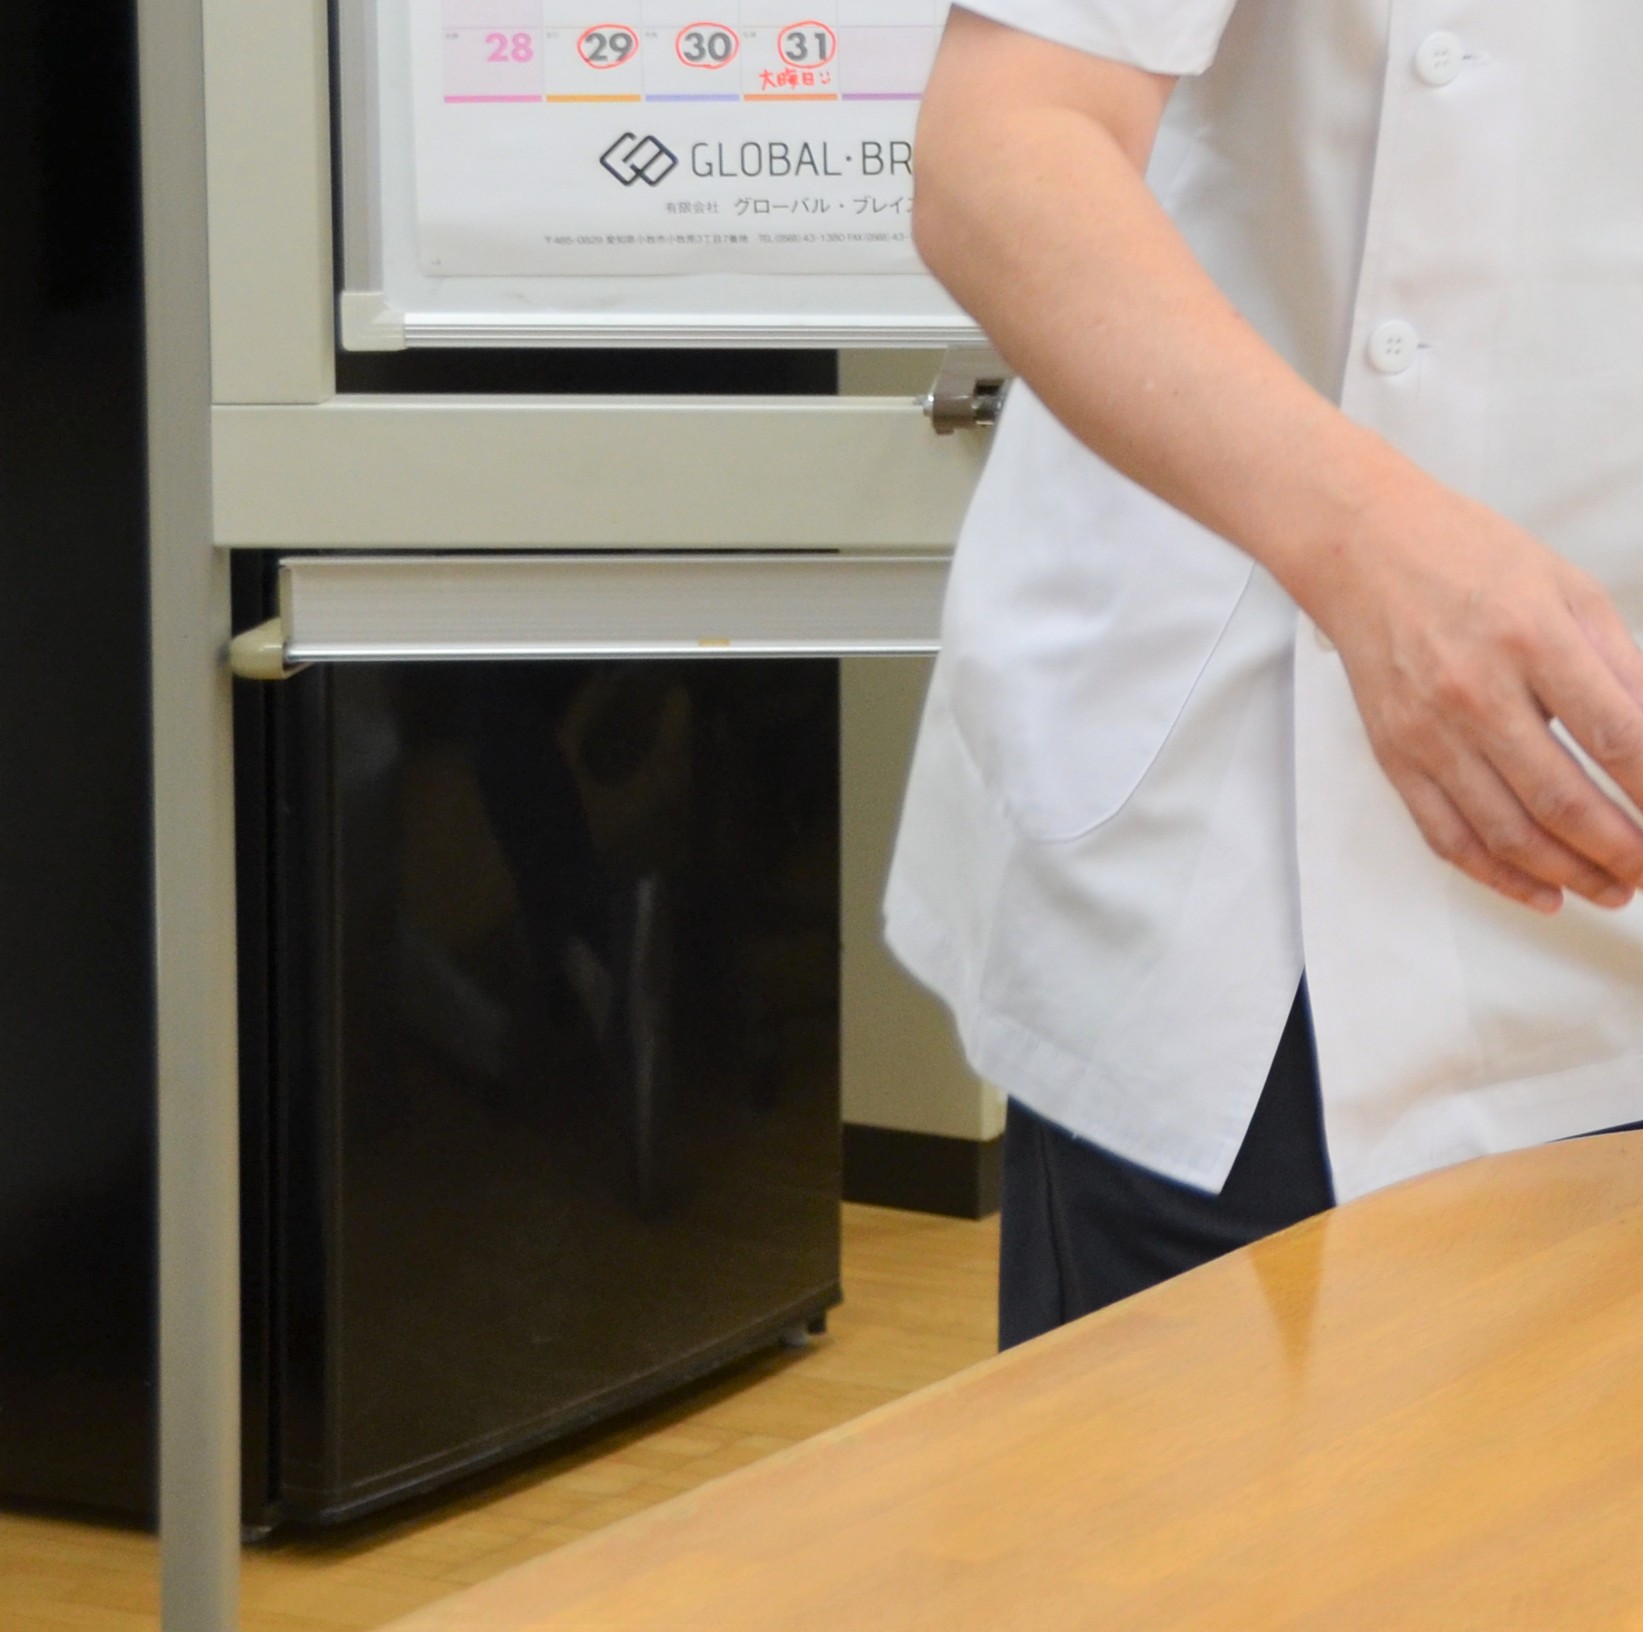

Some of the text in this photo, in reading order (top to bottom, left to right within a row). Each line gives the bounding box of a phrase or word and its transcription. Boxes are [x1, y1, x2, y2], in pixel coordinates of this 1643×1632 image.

[485, 31, 829, 63] 28 29 30 31
[758, 69, 816, 90] 大晦日
[665, 200, 720, 215] 有限会社
